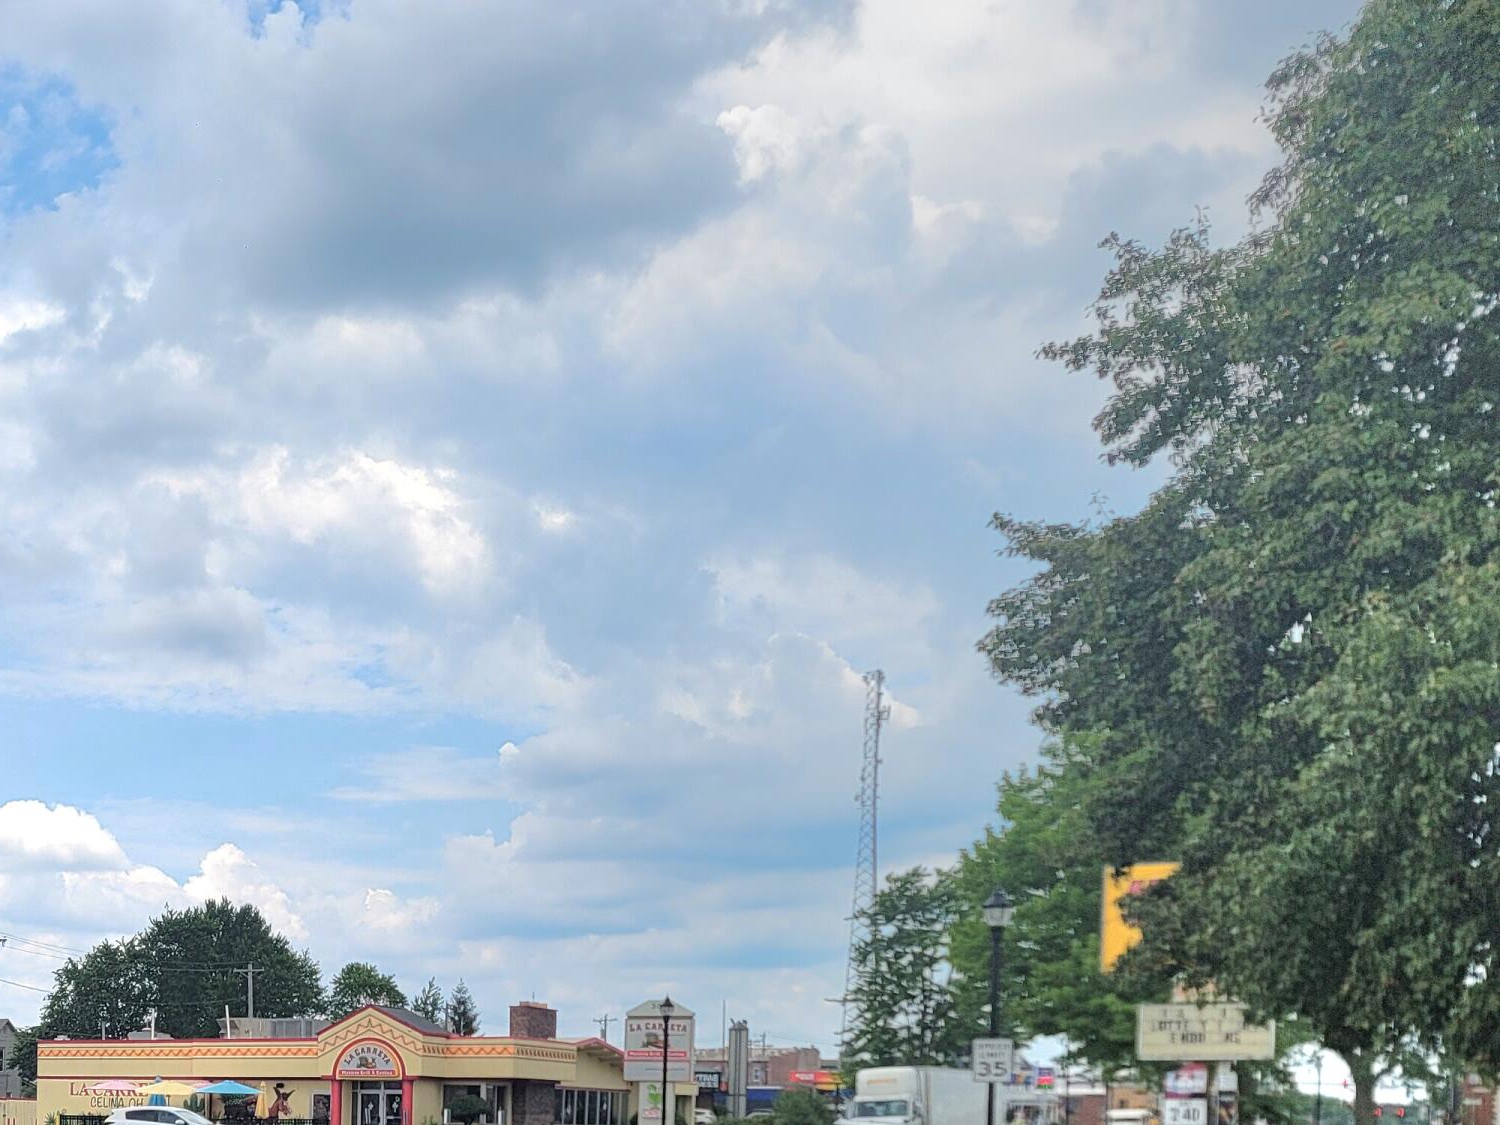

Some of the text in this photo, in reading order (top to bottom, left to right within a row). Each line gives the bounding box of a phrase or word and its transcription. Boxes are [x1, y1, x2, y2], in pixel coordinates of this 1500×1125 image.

[629, 1022, 688, 1033] LA CARETA
[977, 1061, 1008, 1078] 35
